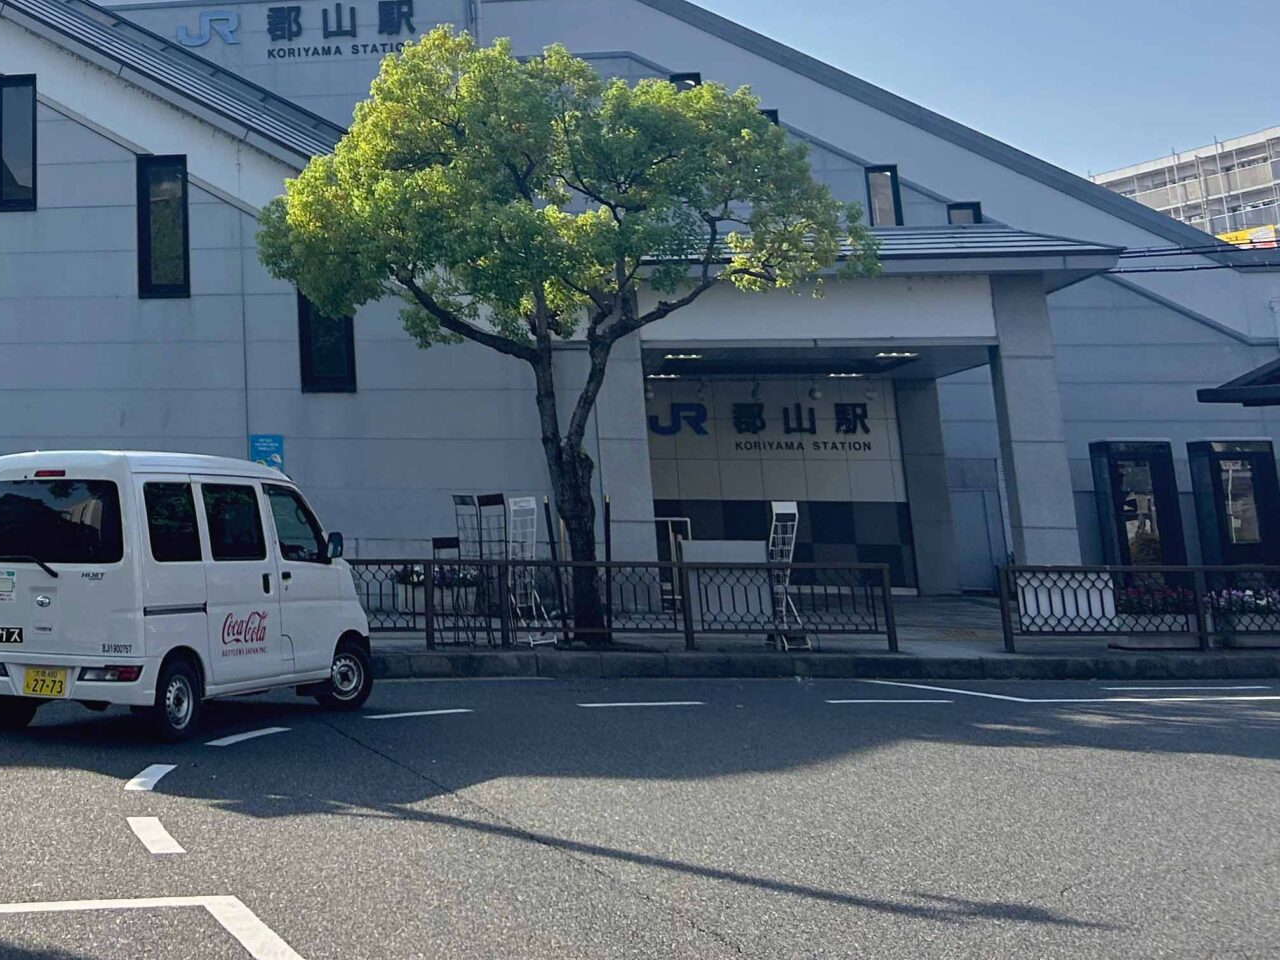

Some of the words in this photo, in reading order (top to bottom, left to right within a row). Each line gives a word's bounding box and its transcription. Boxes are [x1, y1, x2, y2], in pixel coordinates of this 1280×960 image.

[176, 9, 240, 47] JR
[266, 0, 416, 42] 郡山駅
[267, 44, 342, 60] KORIYAMA
[351, 41, 405, 55] STATIO
[648, 402, 709, 436] JR
[732, 402, 871, 435] 郡山駅
[735, 441, 805, 451] KORIYAMA
[812, 441, 872, 451] STATION
[222, 611, 268, 644] Coca-Cola
